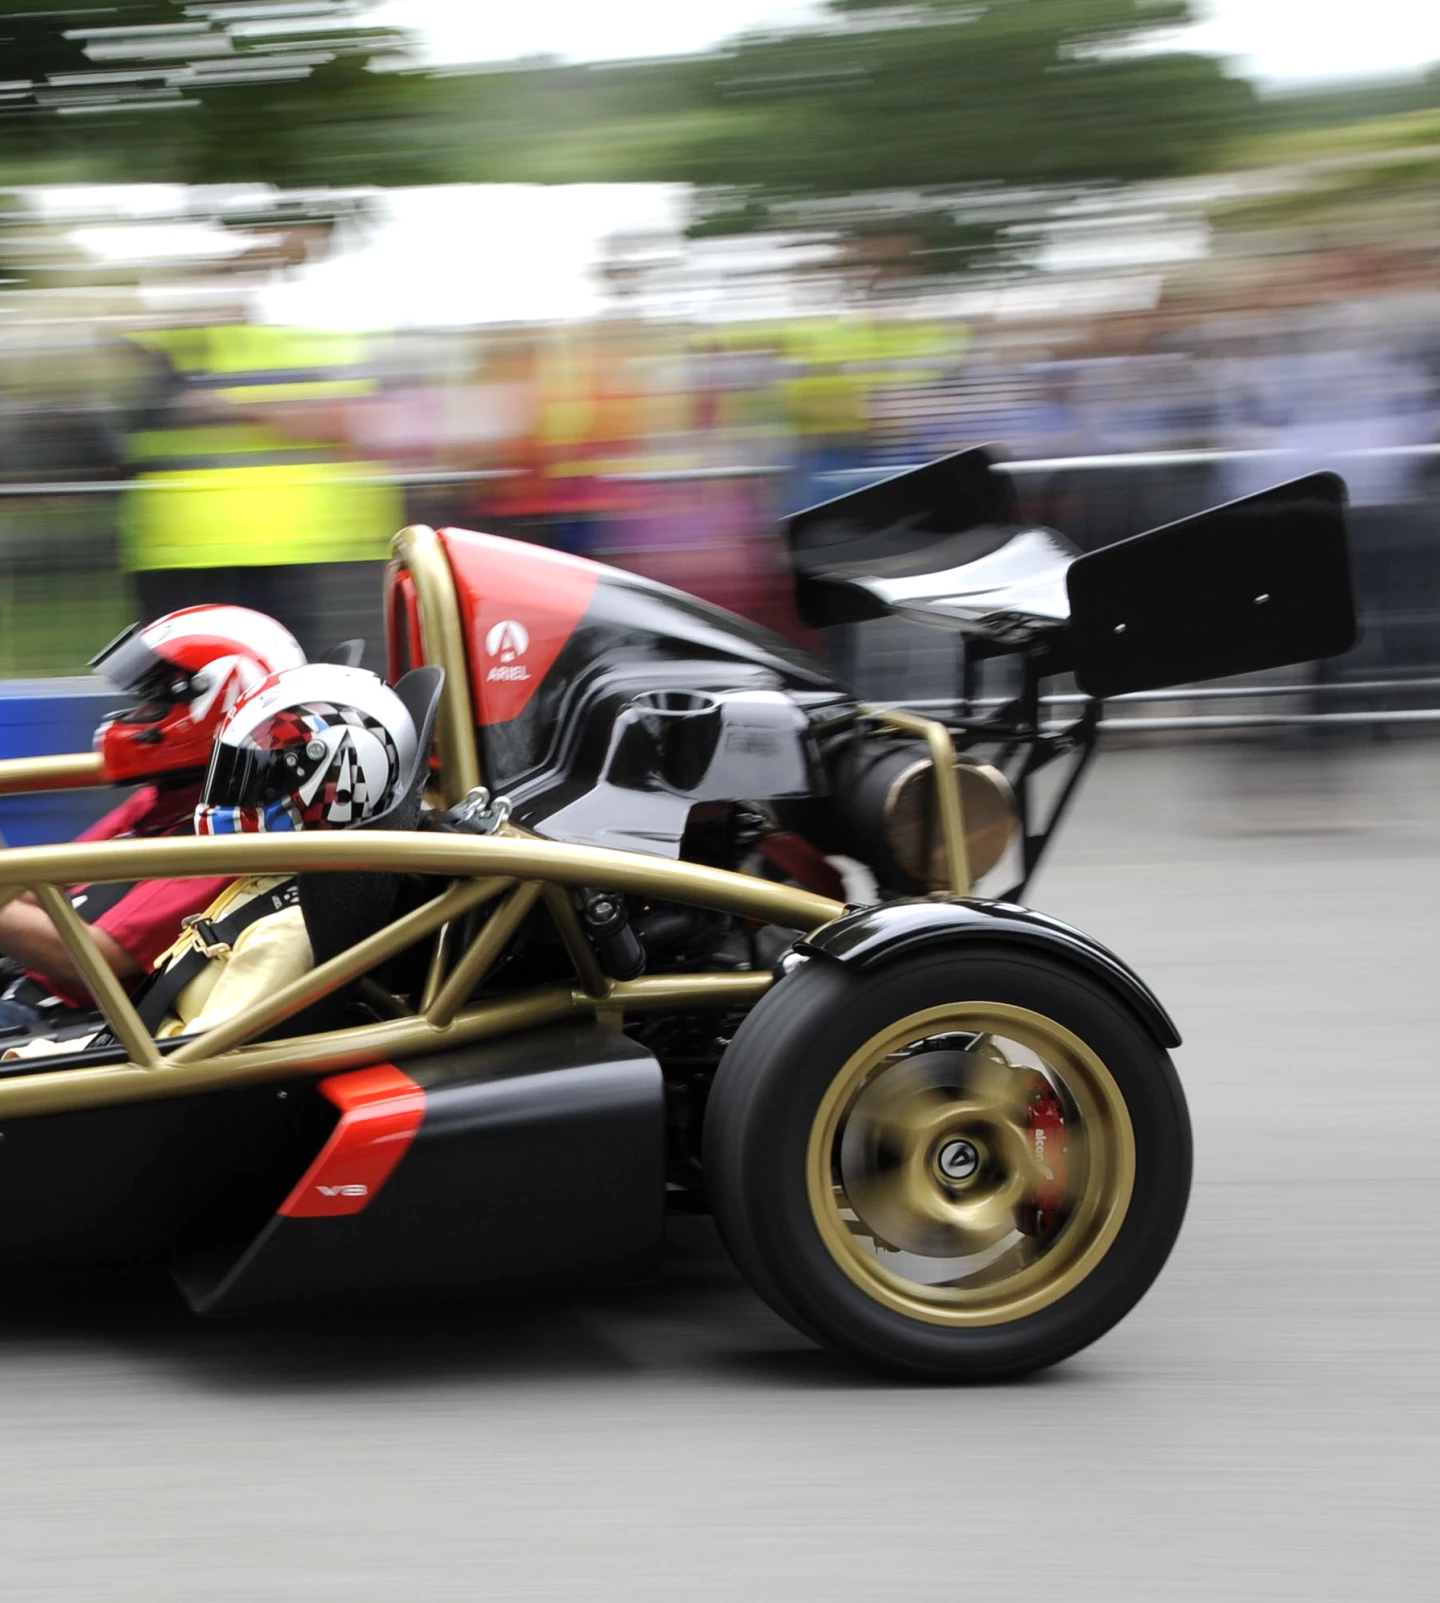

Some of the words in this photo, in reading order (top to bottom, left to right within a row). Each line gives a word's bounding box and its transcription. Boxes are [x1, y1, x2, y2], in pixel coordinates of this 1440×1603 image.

[486, 666, 531, 681] ARIEL
[1035, 1129, 1046, 1165] alcon
[315, 1184, 368, 1197] V8
